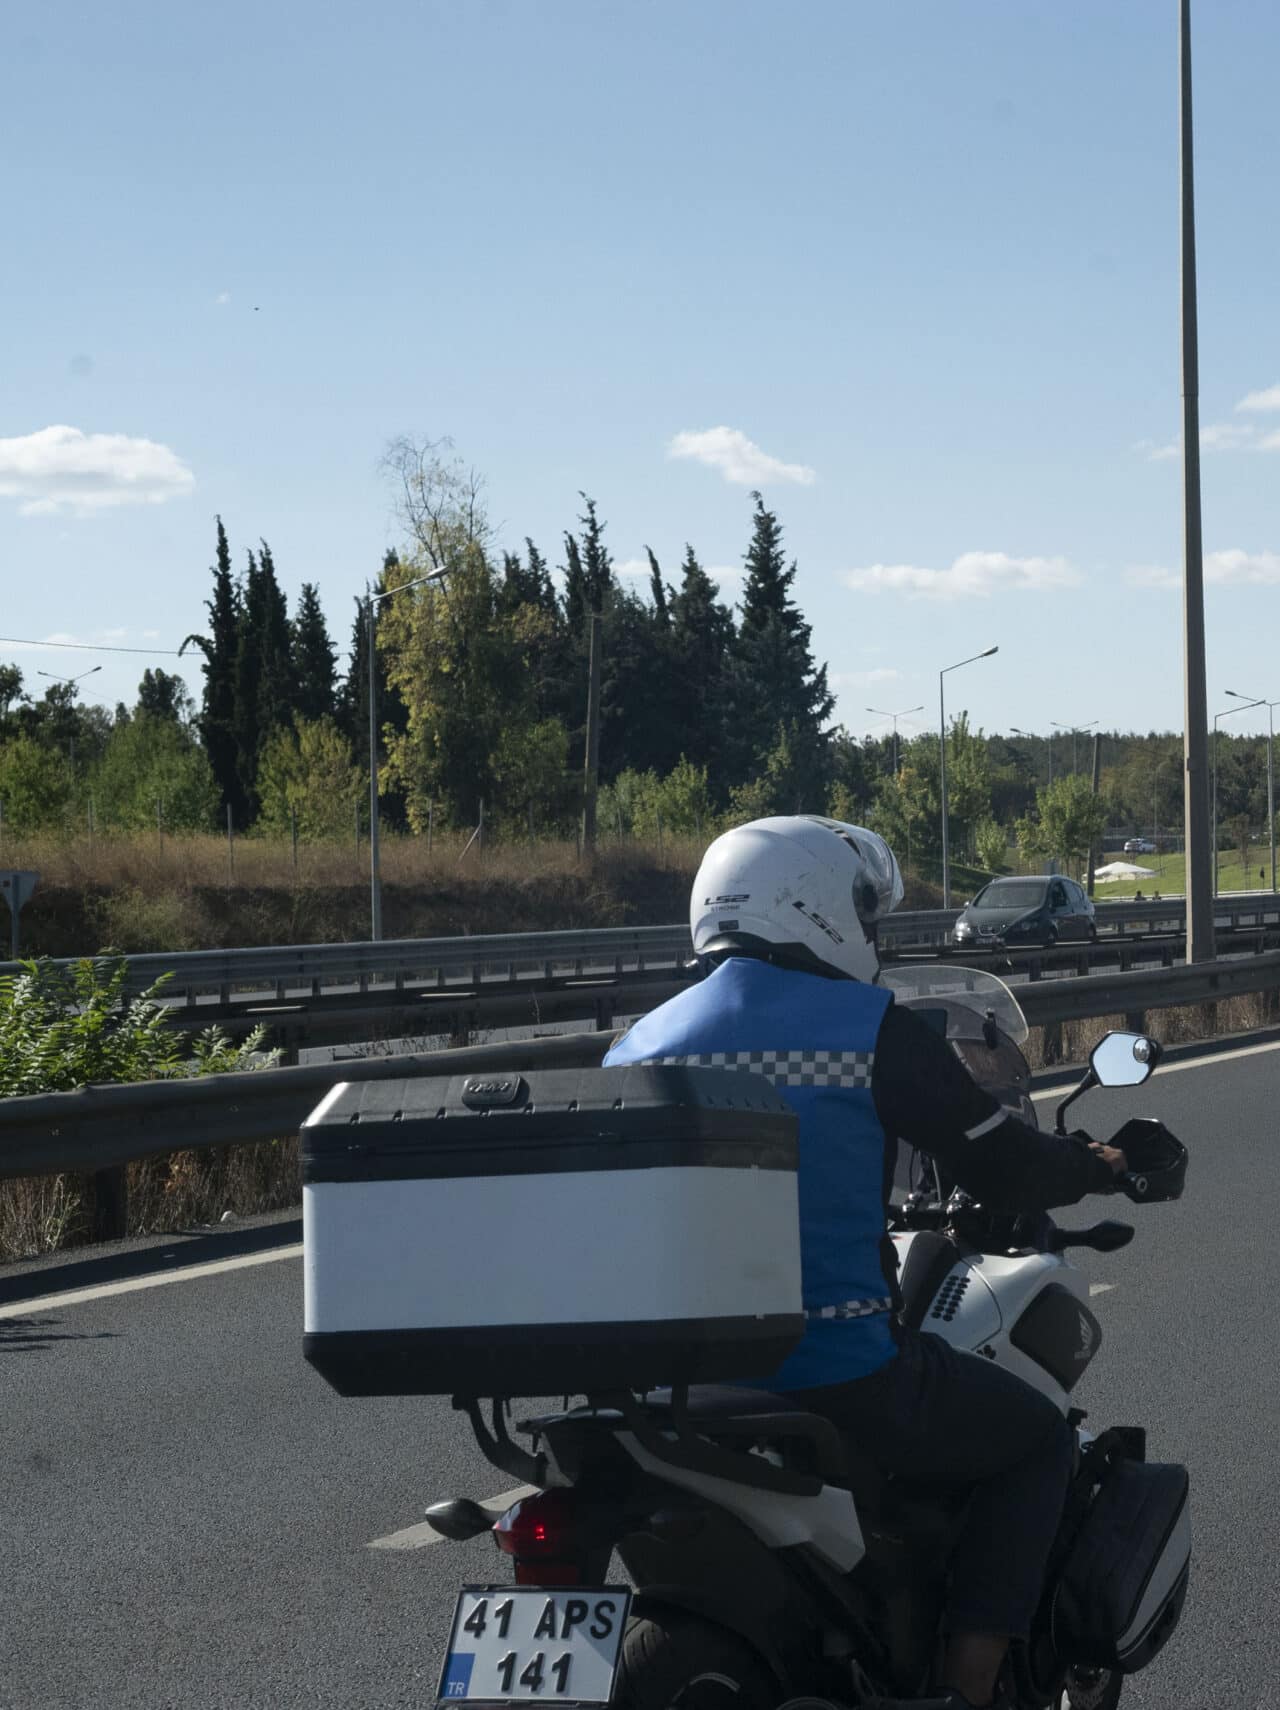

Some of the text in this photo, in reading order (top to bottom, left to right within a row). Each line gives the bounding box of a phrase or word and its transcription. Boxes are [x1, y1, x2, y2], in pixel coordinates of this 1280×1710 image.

[463, 1597, 617, 1640] 41 APS
[448, 1681, 465, 1695] TR
[497, 1651, 572, 1693] 141
